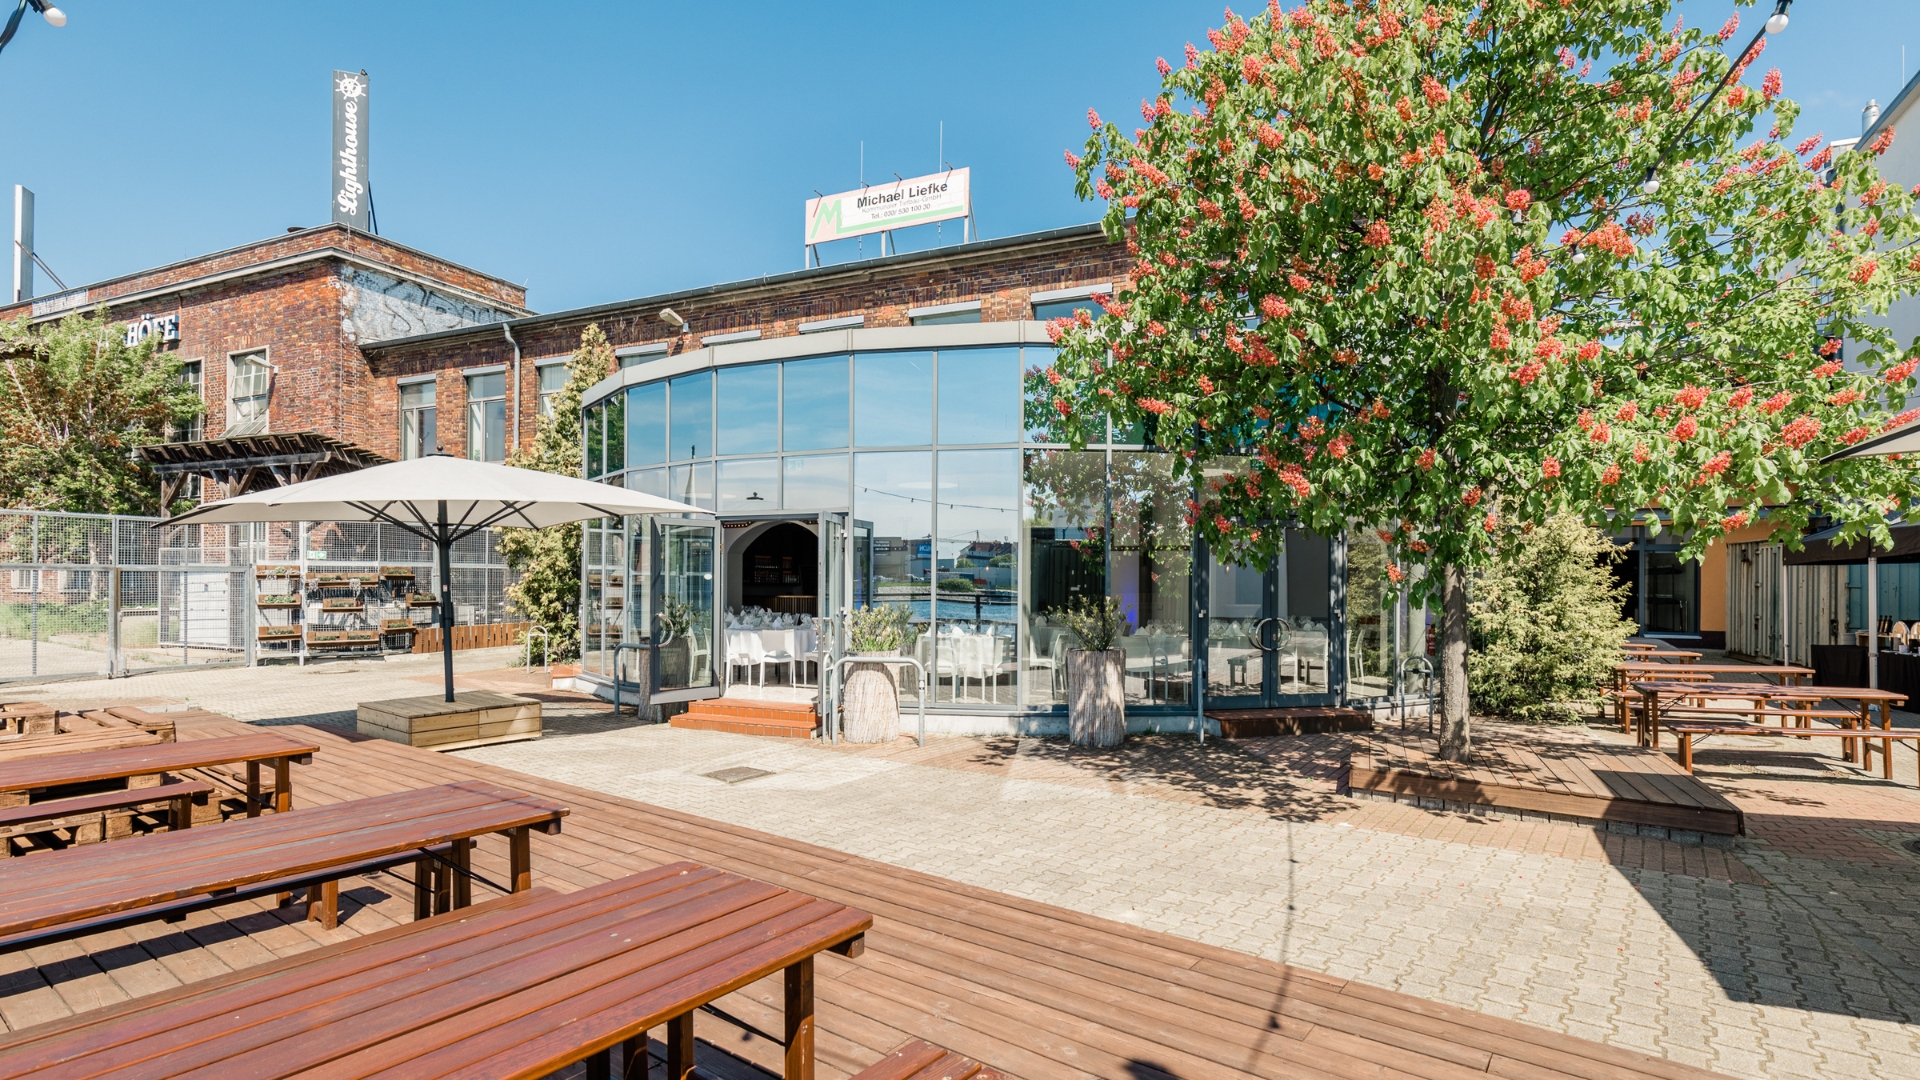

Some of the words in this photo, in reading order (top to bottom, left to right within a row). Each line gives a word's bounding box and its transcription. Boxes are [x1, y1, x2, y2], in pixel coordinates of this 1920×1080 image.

[337, 100, 364, 216] Lighthouse
[857, 189, 904, 208] Michael
[909, 183, 948, 198] Liefke
[861, 203, 897, 214] Kommunaler
